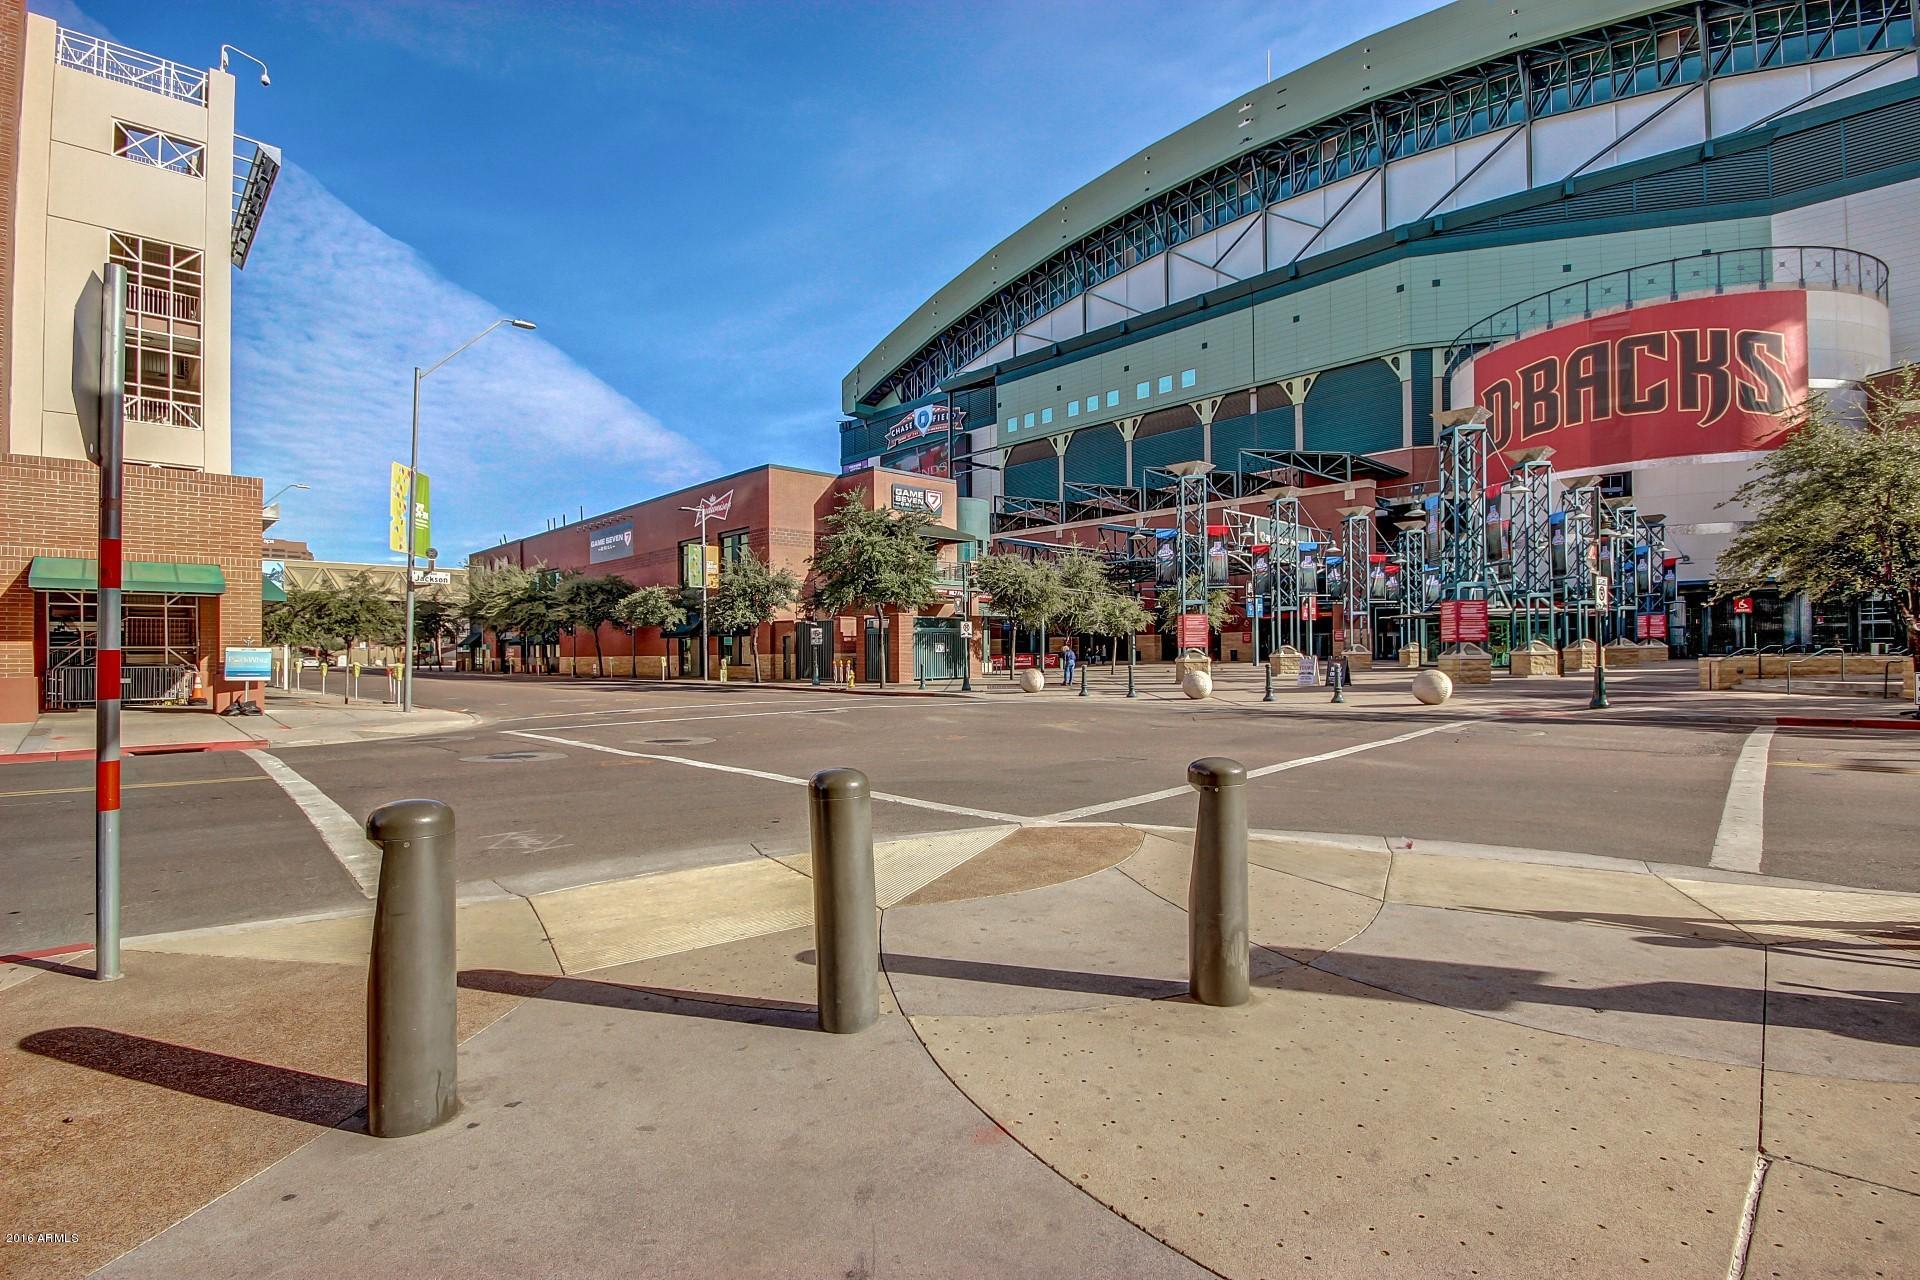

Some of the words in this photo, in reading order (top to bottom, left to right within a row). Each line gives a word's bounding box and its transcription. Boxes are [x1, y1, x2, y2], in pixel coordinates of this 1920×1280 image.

[891, 421, 913, 437] CHASE
[895, 488, 924, 499] GAME
[895, 495, 924, 505] SEVEN
[930, 494, 939, 505] 7
[591, 538, 605, 548] GAME
[605, 533, 624, 545] SEVEN
[415, 575, 448, 583] Jackson
